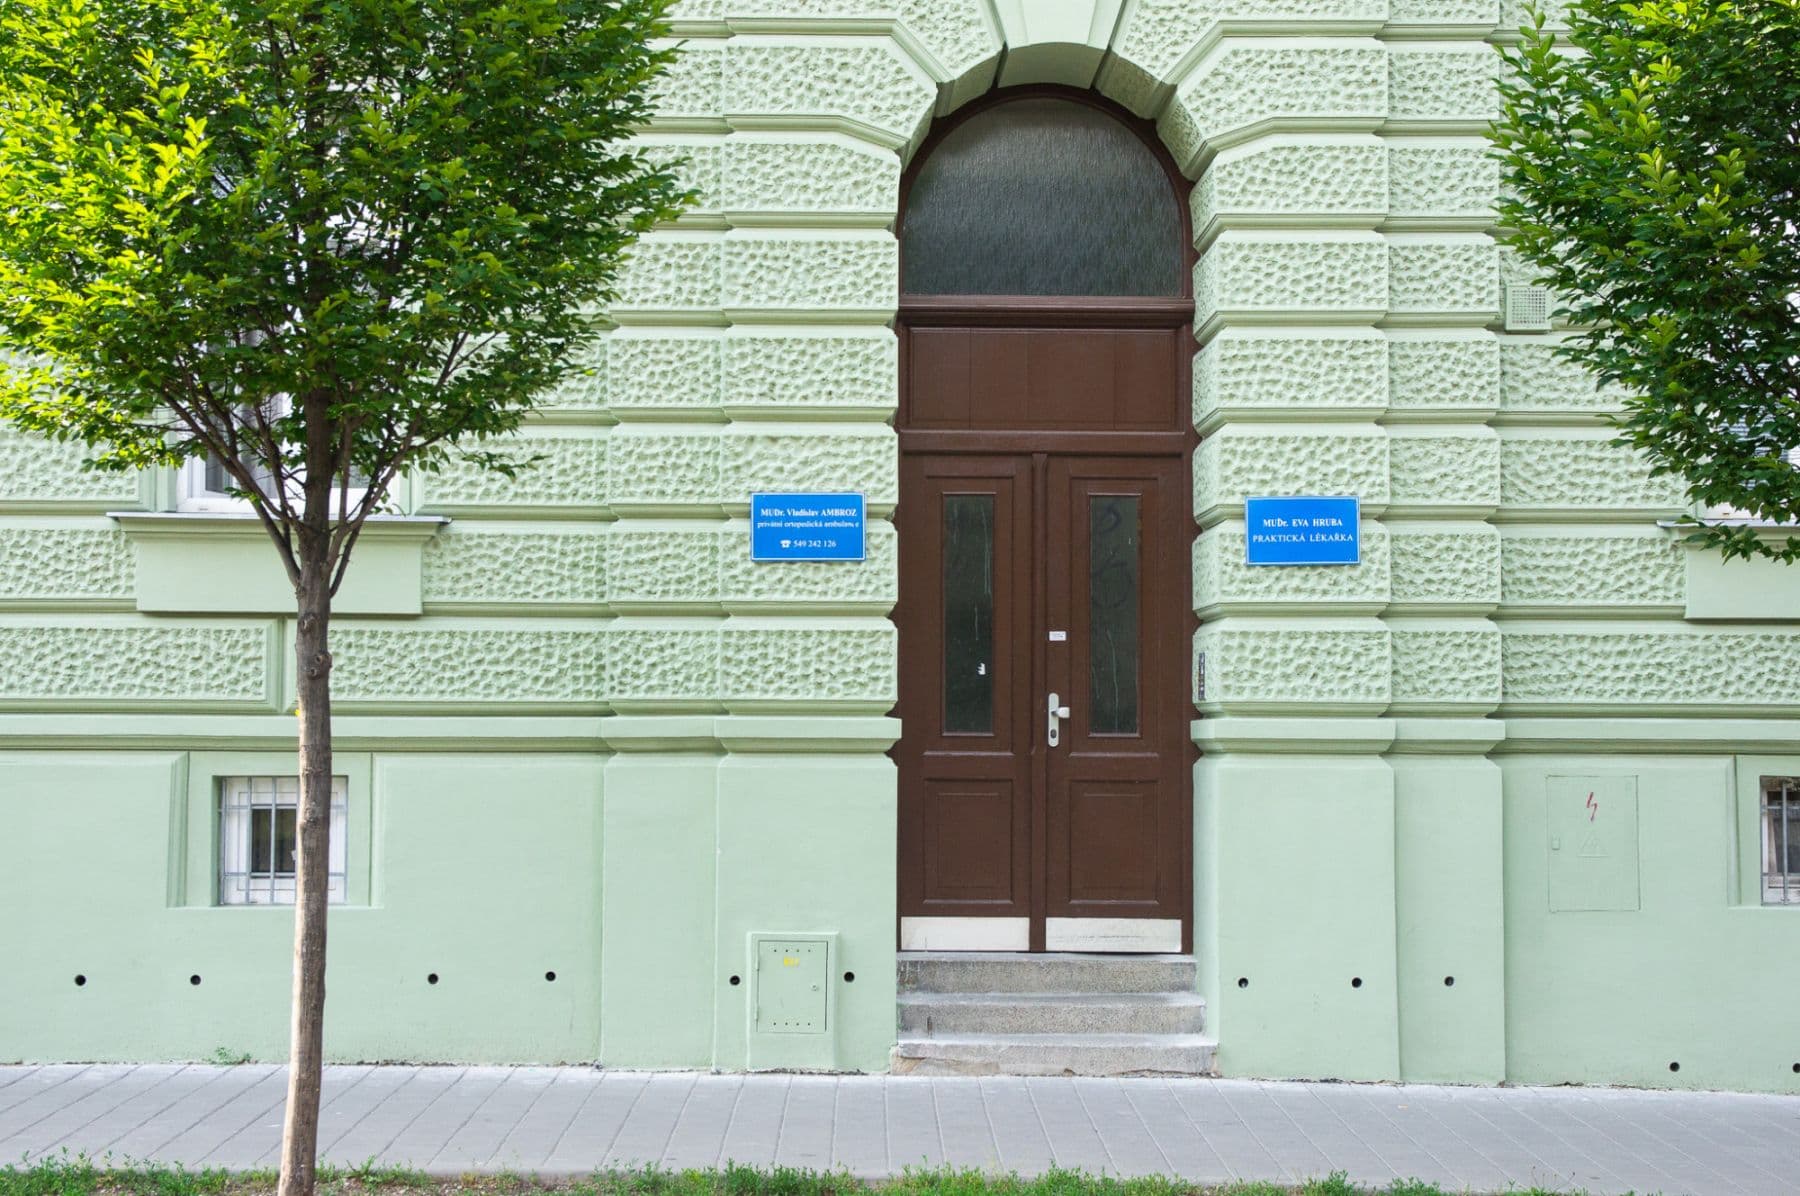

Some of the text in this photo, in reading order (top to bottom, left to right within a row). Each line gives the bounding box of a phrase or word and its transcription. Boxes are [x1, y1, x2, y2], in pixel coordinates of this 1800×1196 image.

[760, 507, 786, 517] MUDr.
[786, 507, 819, 517] Vladislav
[1263, 517, 1289, 528] MUDr.
[1292, 518, 1309, 528] EVA
[1252, 532, 1306, 543] PRAKTICKÁ
[807, 539, 822, 549] 242
[824, 539, 837, 549] 126
